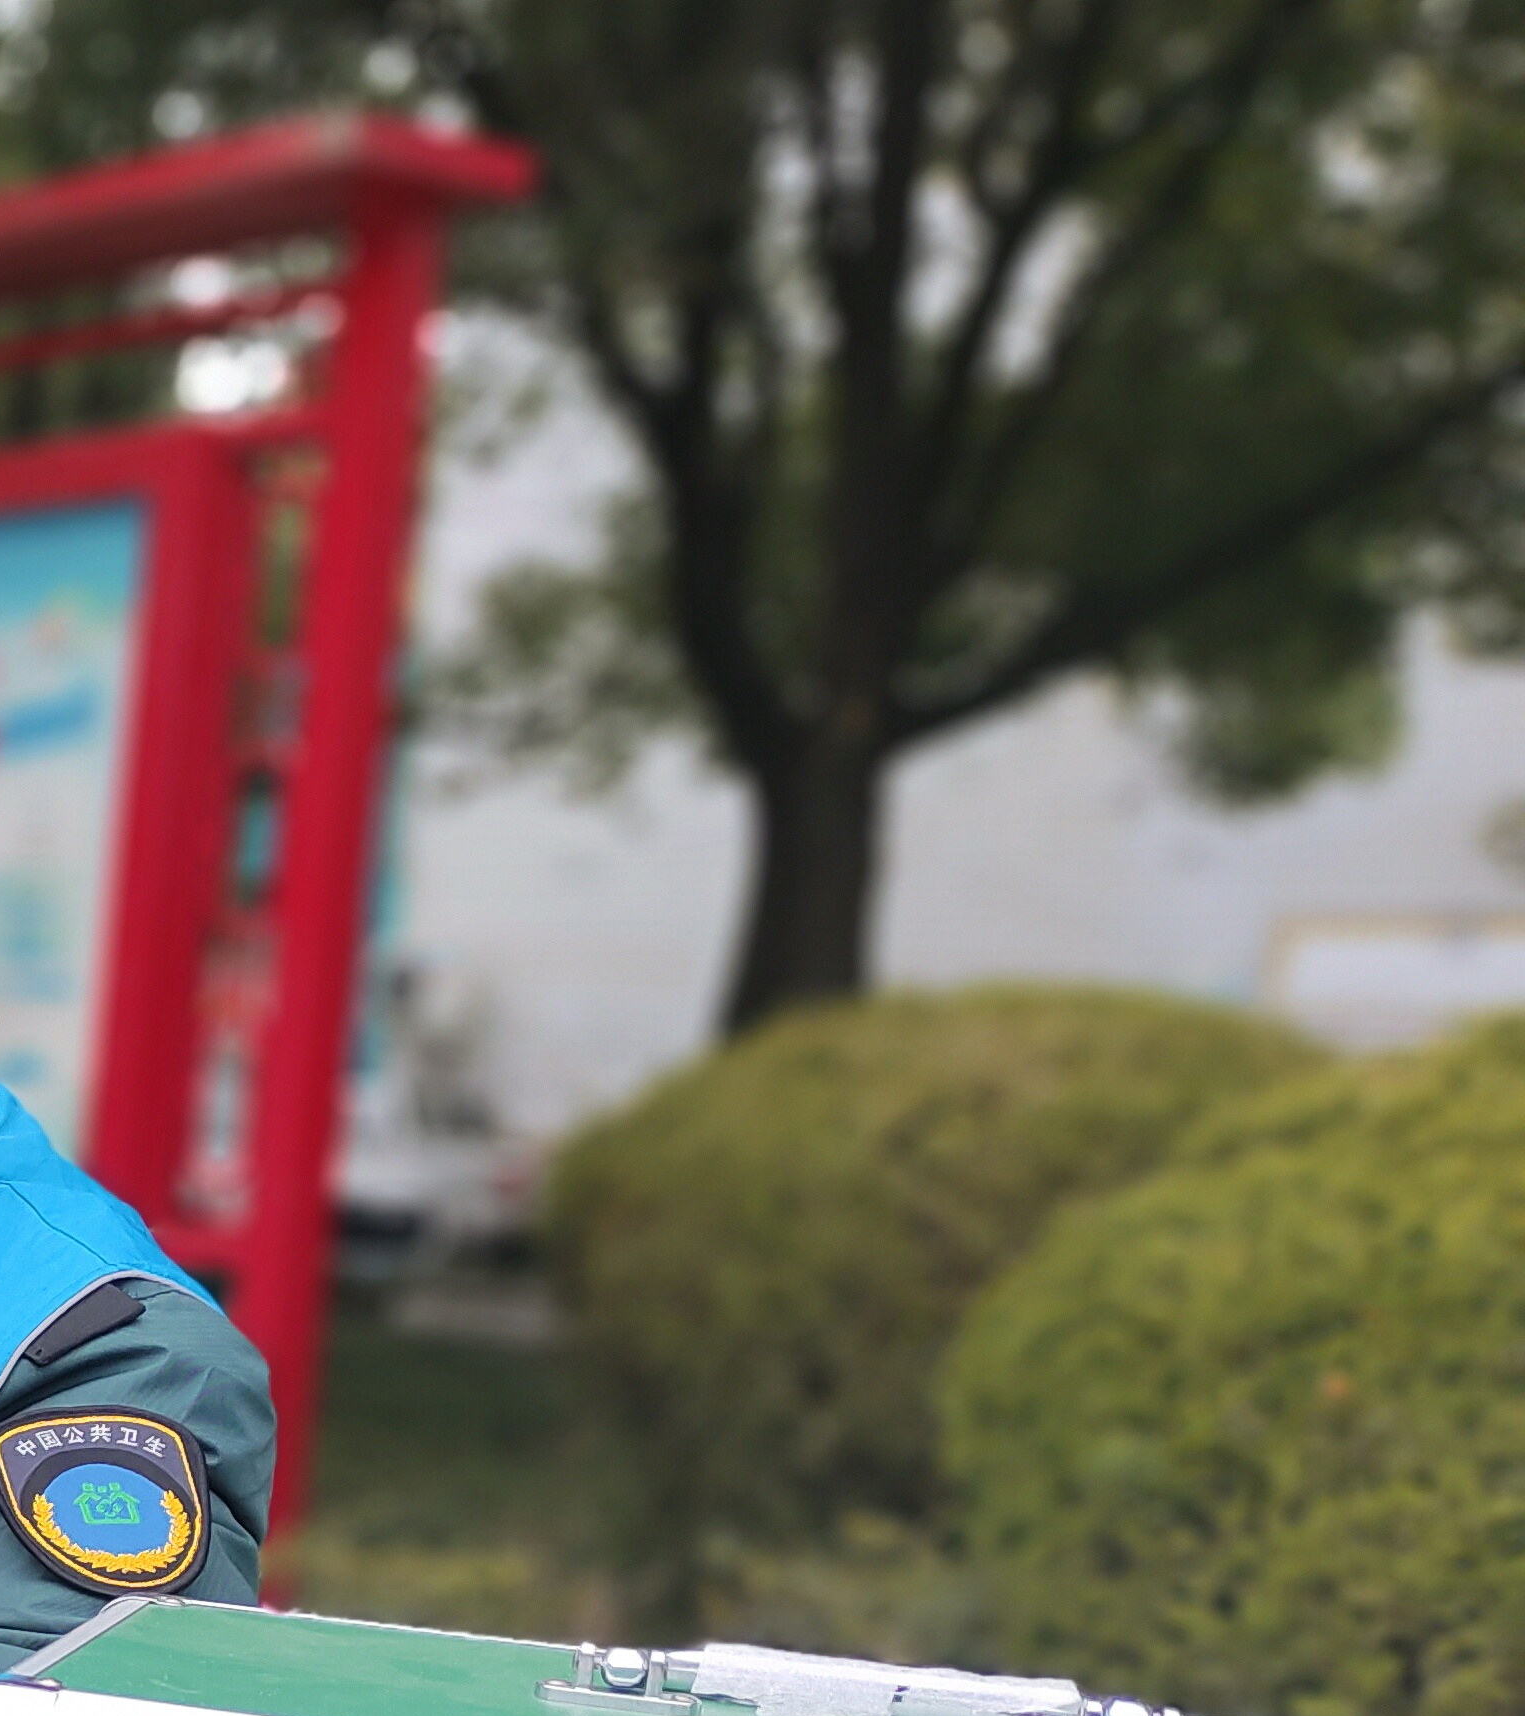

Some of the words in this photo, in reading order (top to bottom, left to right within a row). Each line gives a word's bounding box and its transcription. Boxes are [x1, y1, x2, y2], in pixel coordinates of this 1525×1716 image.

[14, 1422, 168, 1461] 中国公共卫生
